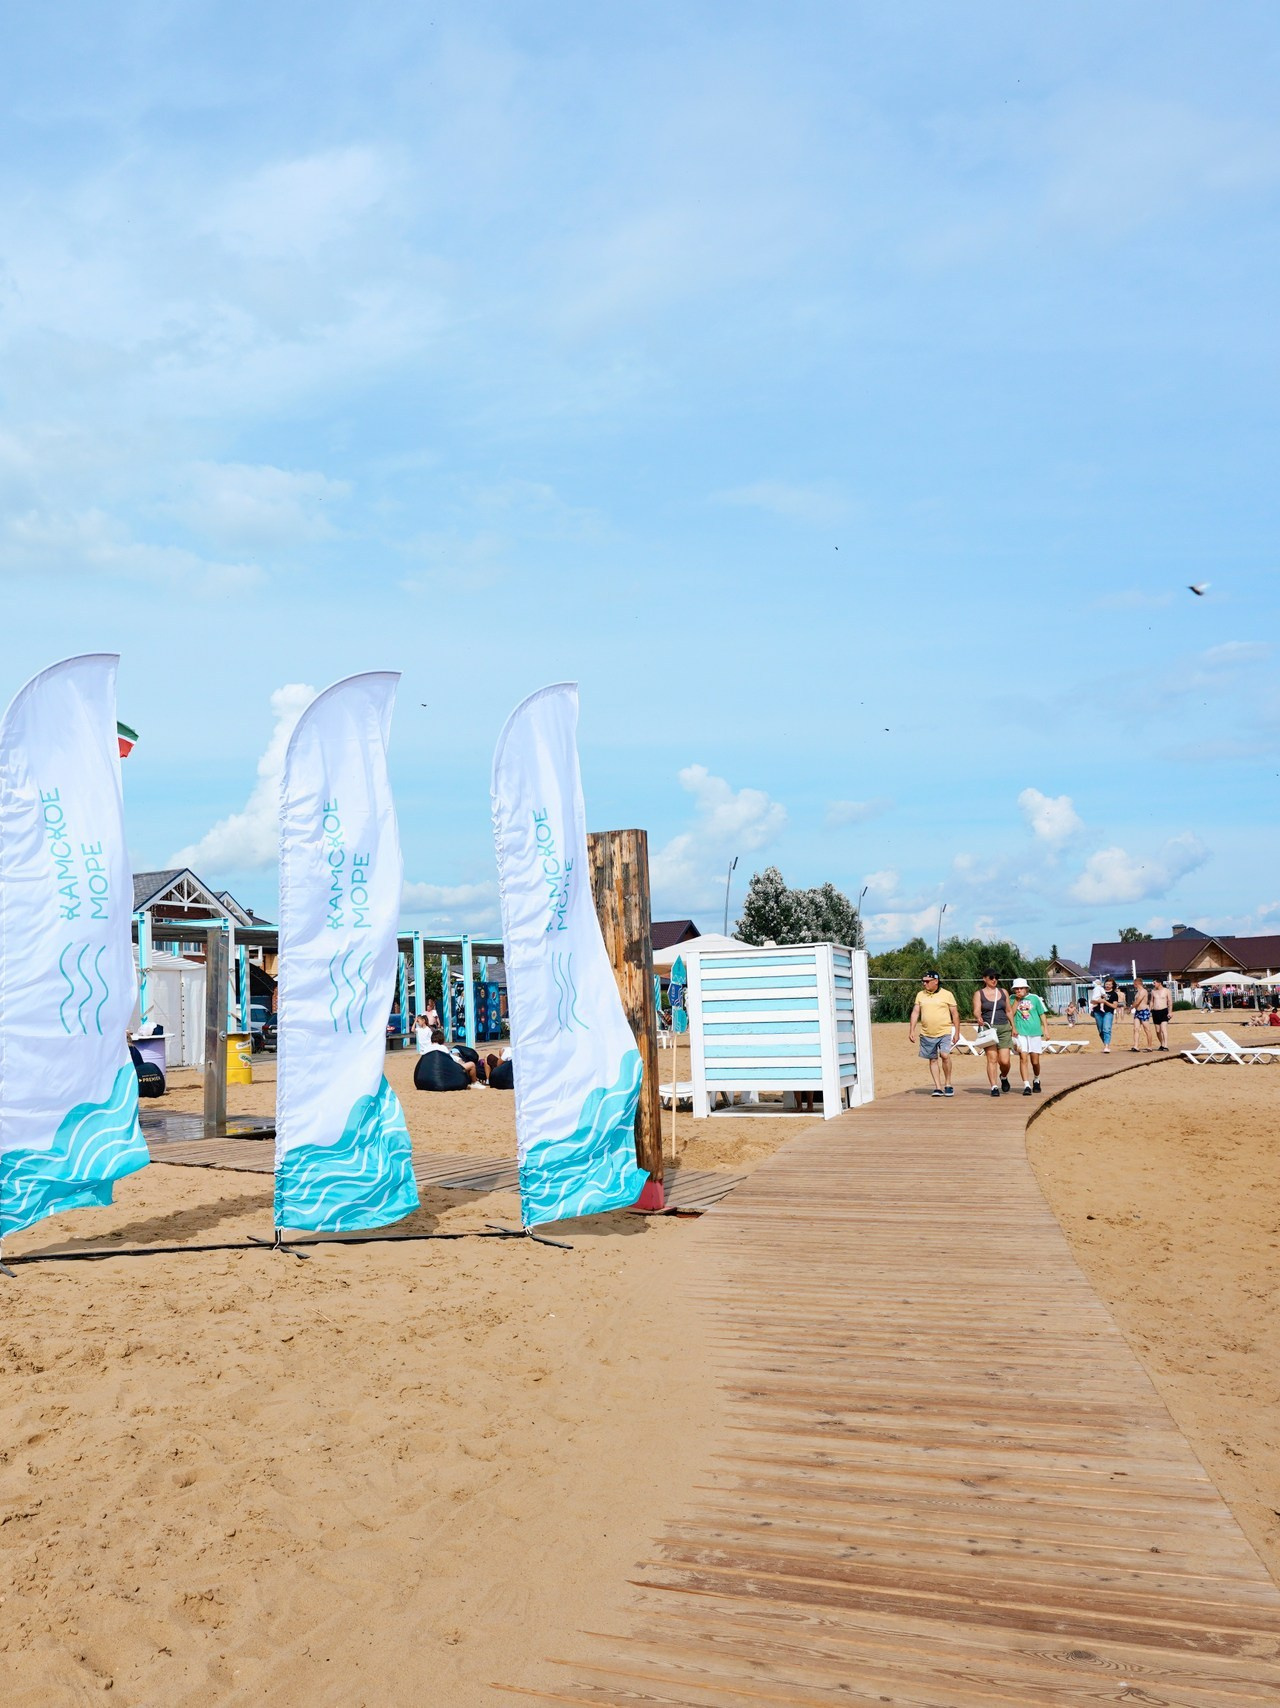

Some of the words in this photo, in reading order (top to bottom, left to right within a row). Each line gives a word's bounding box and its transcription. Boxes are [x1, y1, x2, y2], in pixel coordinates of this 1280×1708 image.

[40, 787, 81, 920] КАМСКОЕ
[81, 840, 109, 919] МОРЕ
[322, 798, 345, 930] КАМСКОЕ
[350, 852, 372, 928] МОРЕ
[557, 857, 574, 931] МОЕ
